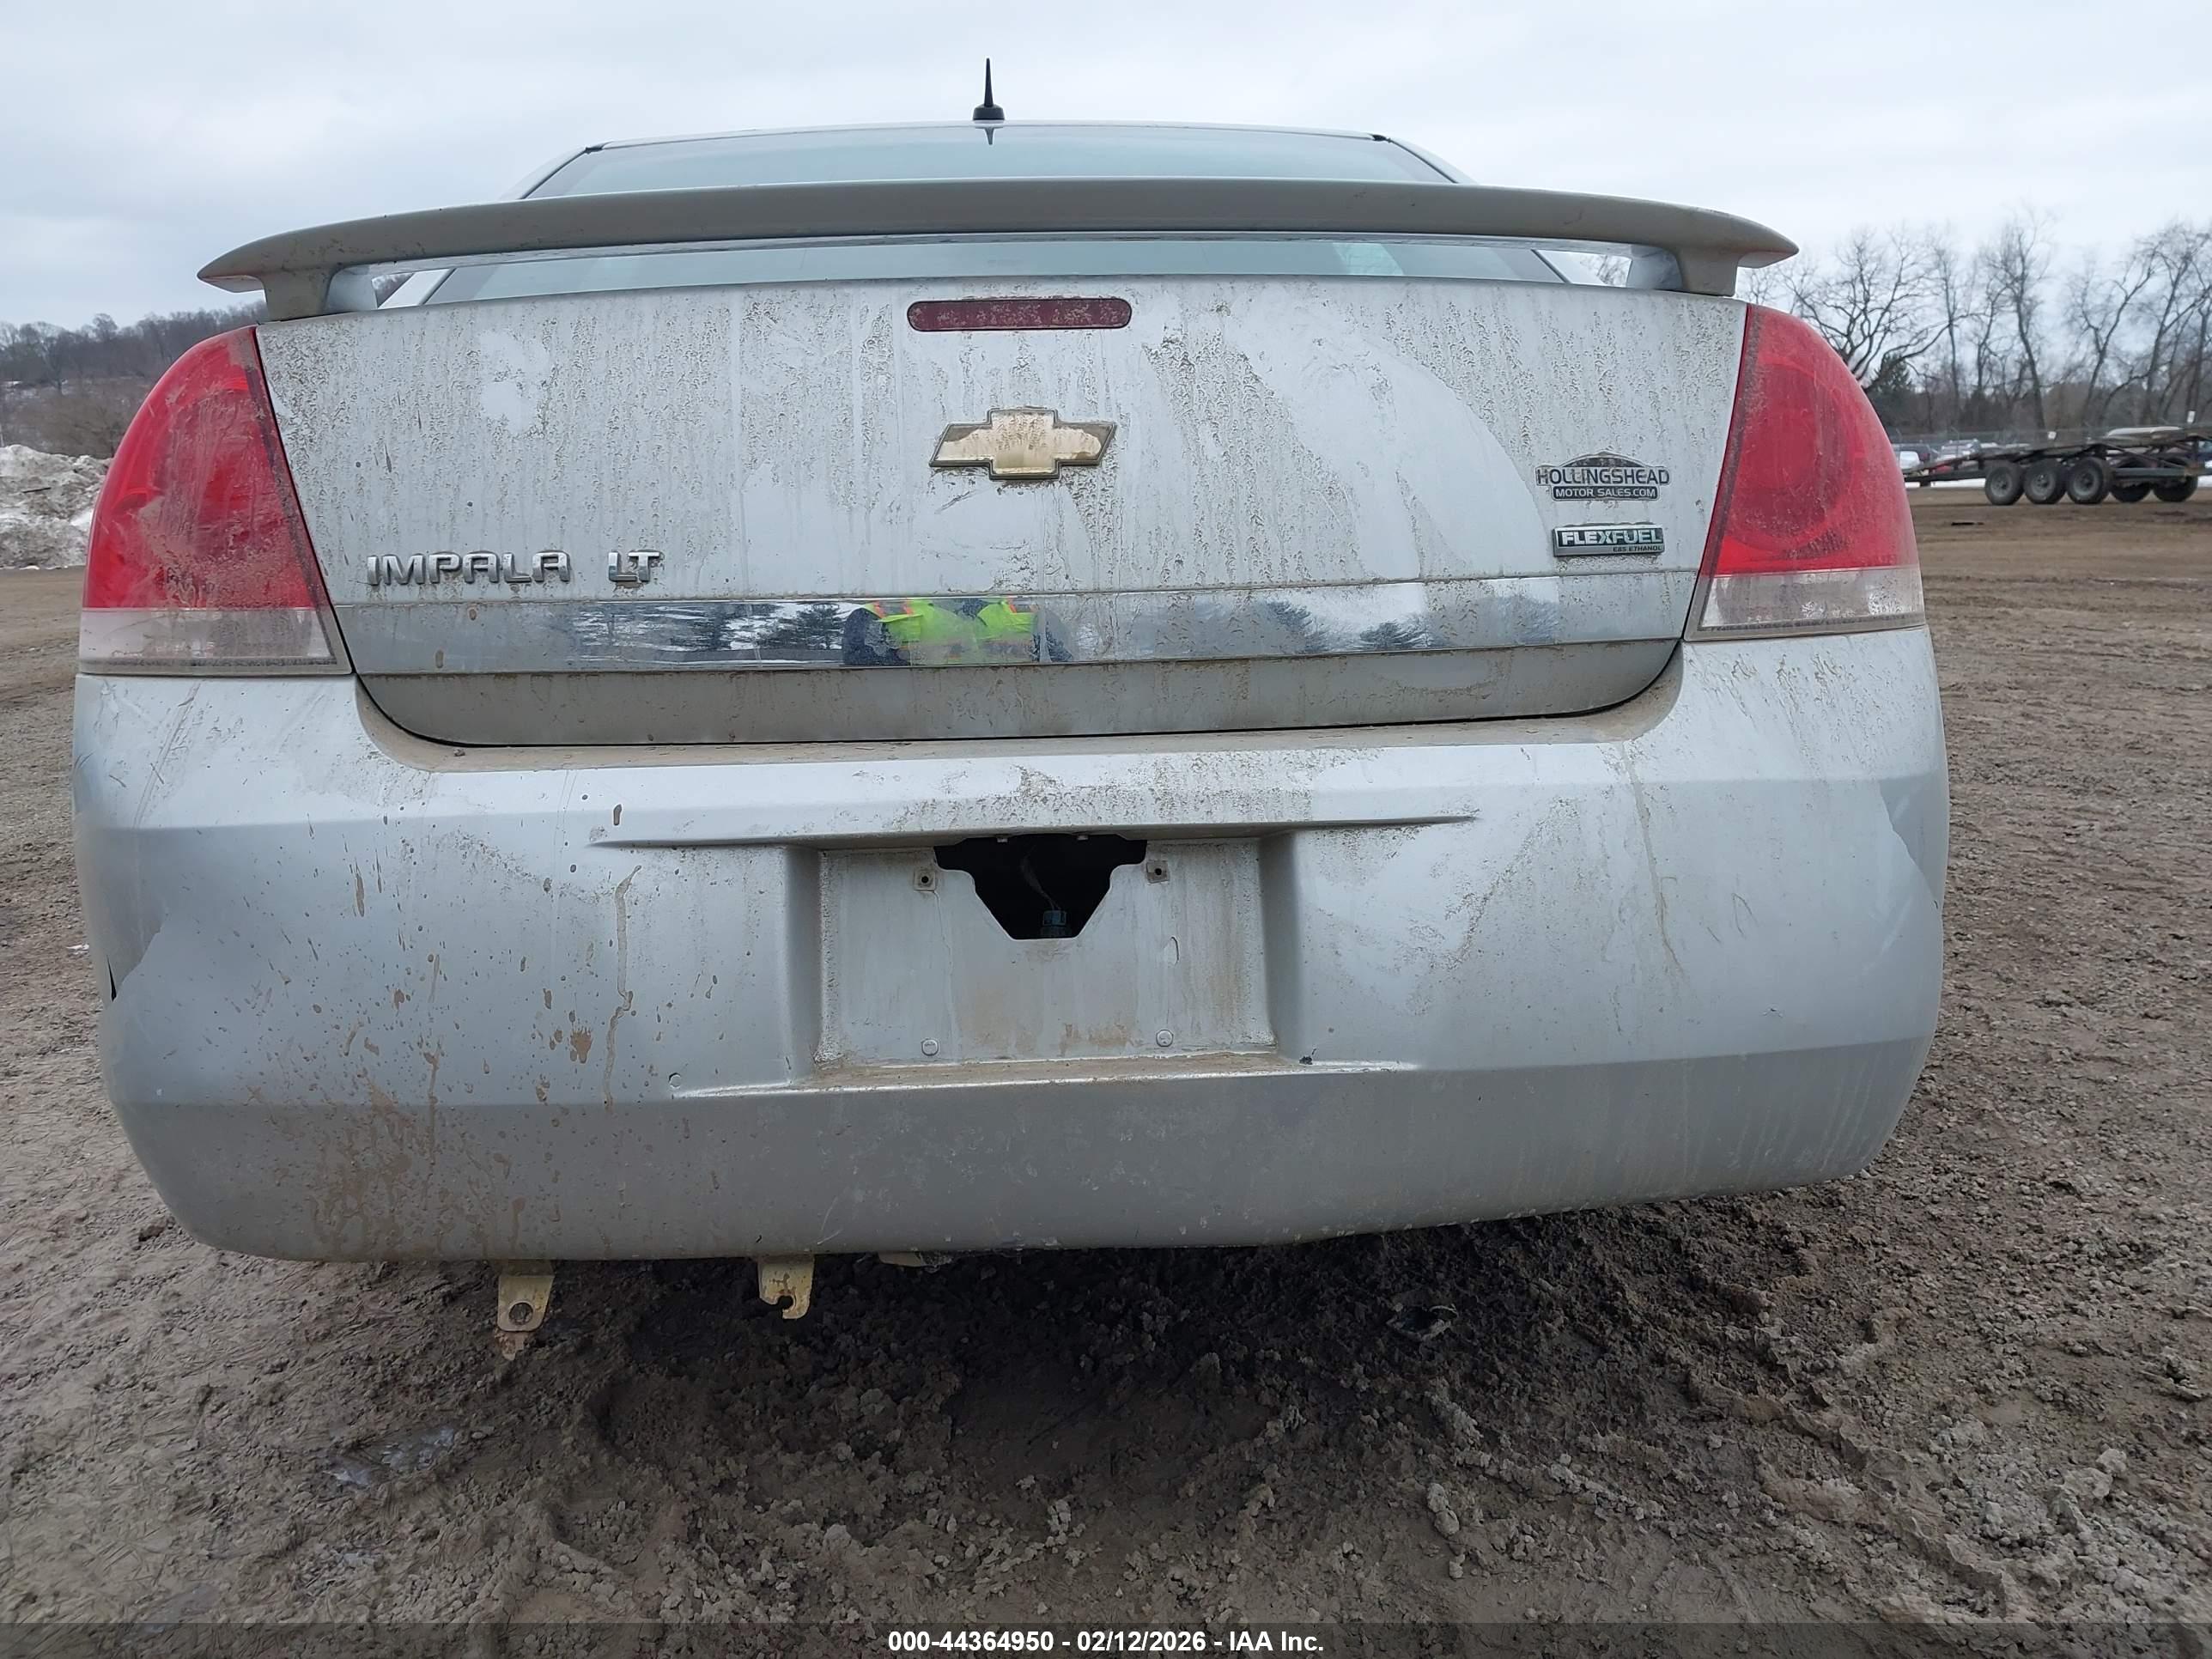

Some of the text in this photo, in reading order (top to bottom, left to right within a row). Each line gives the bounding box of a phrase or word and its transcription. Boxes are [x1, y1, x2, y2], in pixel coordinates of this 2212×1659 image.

[1537, 468, 1669, 484] HOLLINGSHEAD
[1555, 489, 1594, 497] MOTOR
[1561, 530, 1662, 545] FLEXFUEL
[367, 550, 661, 586] IMPALA LT
